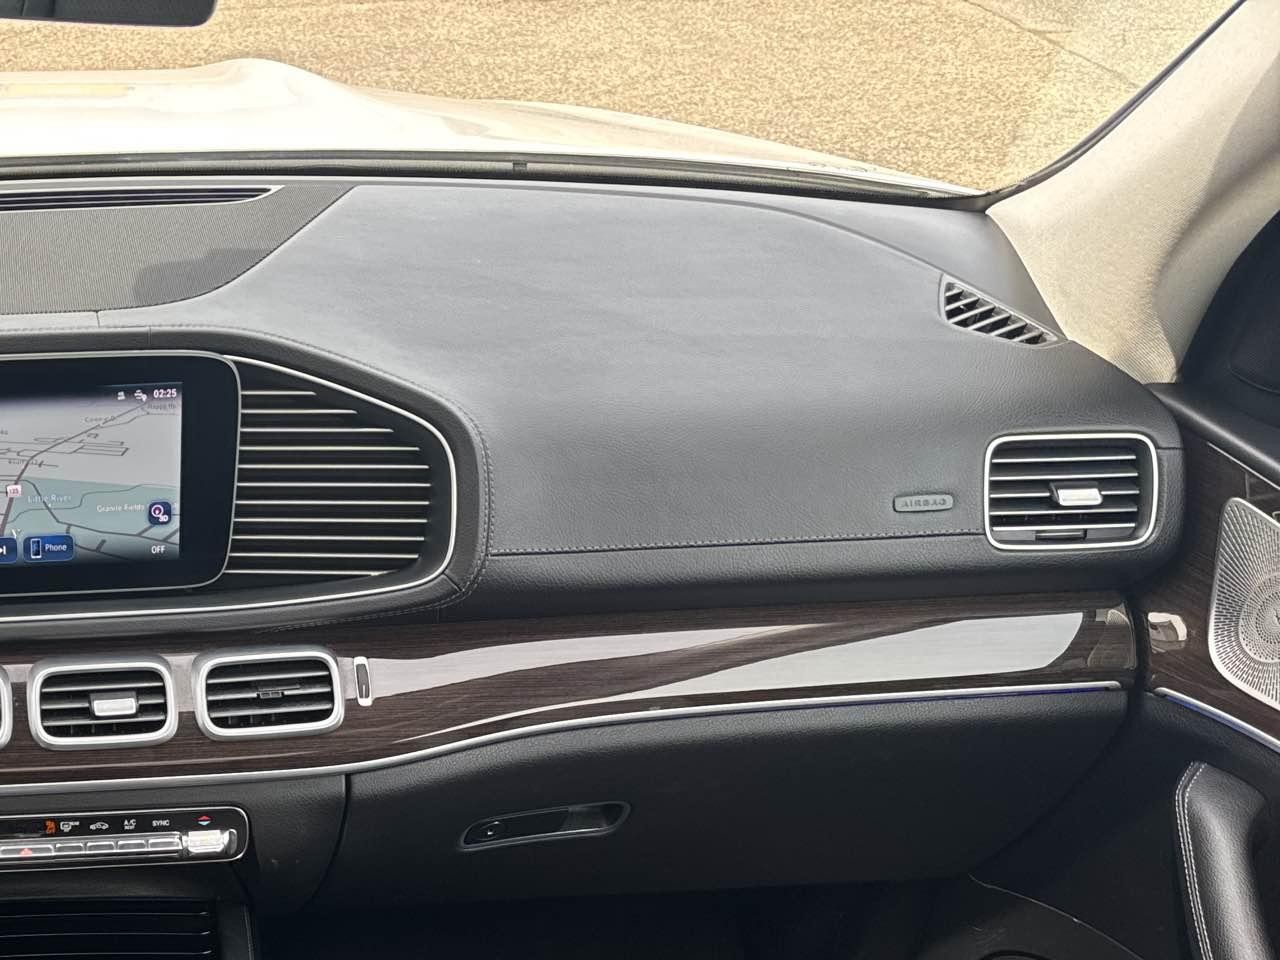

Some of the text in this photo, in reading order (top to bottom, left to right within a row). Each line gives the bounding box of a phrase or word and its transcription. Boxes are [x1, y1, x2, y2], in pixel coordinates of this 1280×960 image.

[153, 388, 177, 398] 02:25
[96, 504, 122, 512] Granite
[44, 543, 67, 552] Phone
[151, 545, 166, 554] OFF
[124, 818, 136, 826] A/C
